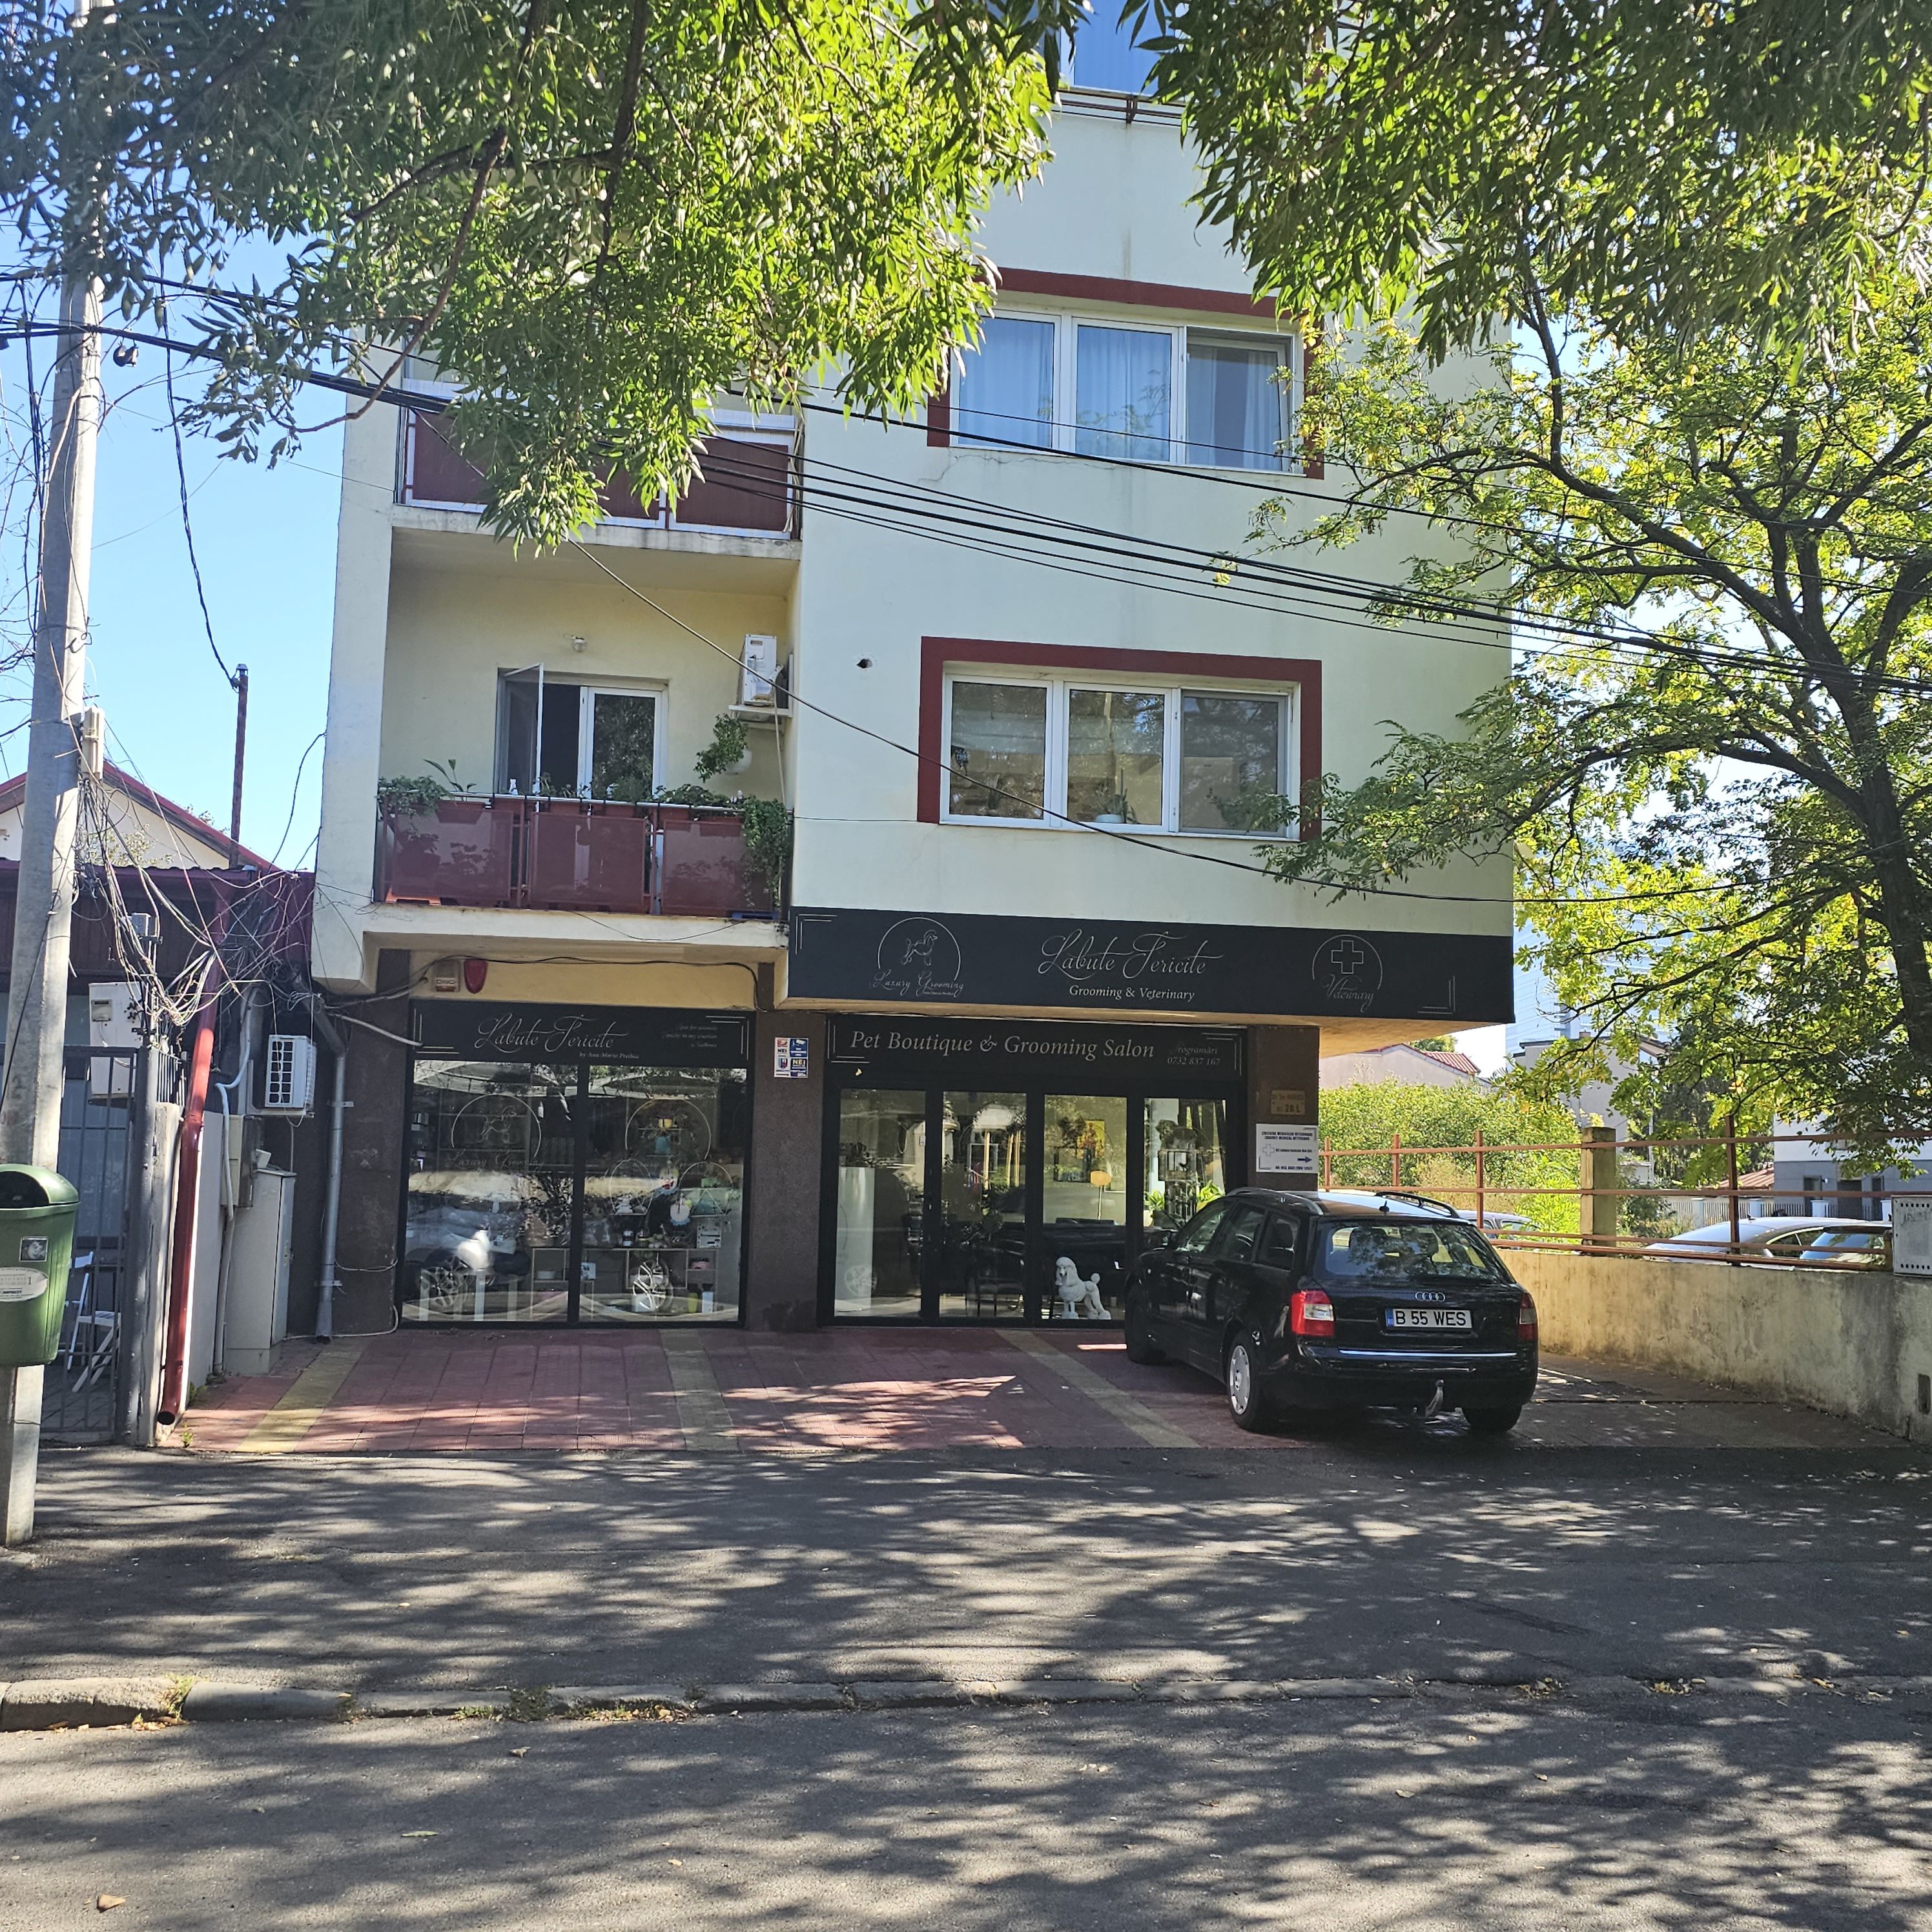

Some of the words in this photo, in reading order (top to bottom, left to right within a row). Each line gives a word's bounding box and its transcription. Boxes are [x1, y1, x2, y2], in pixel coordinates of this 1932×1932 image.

[872, 969, 910, 996] Luxury
[916, 971, 964, 998] Grooming
[1069, 985, 1122, 1000] Grooming
[1125, 987, 1135, 998] &
[1140, 987, 1195, 1002] Veterinary
[1320, 974, 1374, 1013] Veterinary
[850, 1031, 880, 1049] Pet
[887, 1032, 973, 1056] Boutique
[980, 1035, 998, 1052] &
[1004, 1036, 1098, 1061] Grooming
[1103, 1039, 1155, 1058] Salon
[1395, 1310, 1406, 1325] B
[1411, 1310, 1428, 1326] 55
[1433, 1311, 1466, 1326] WES
